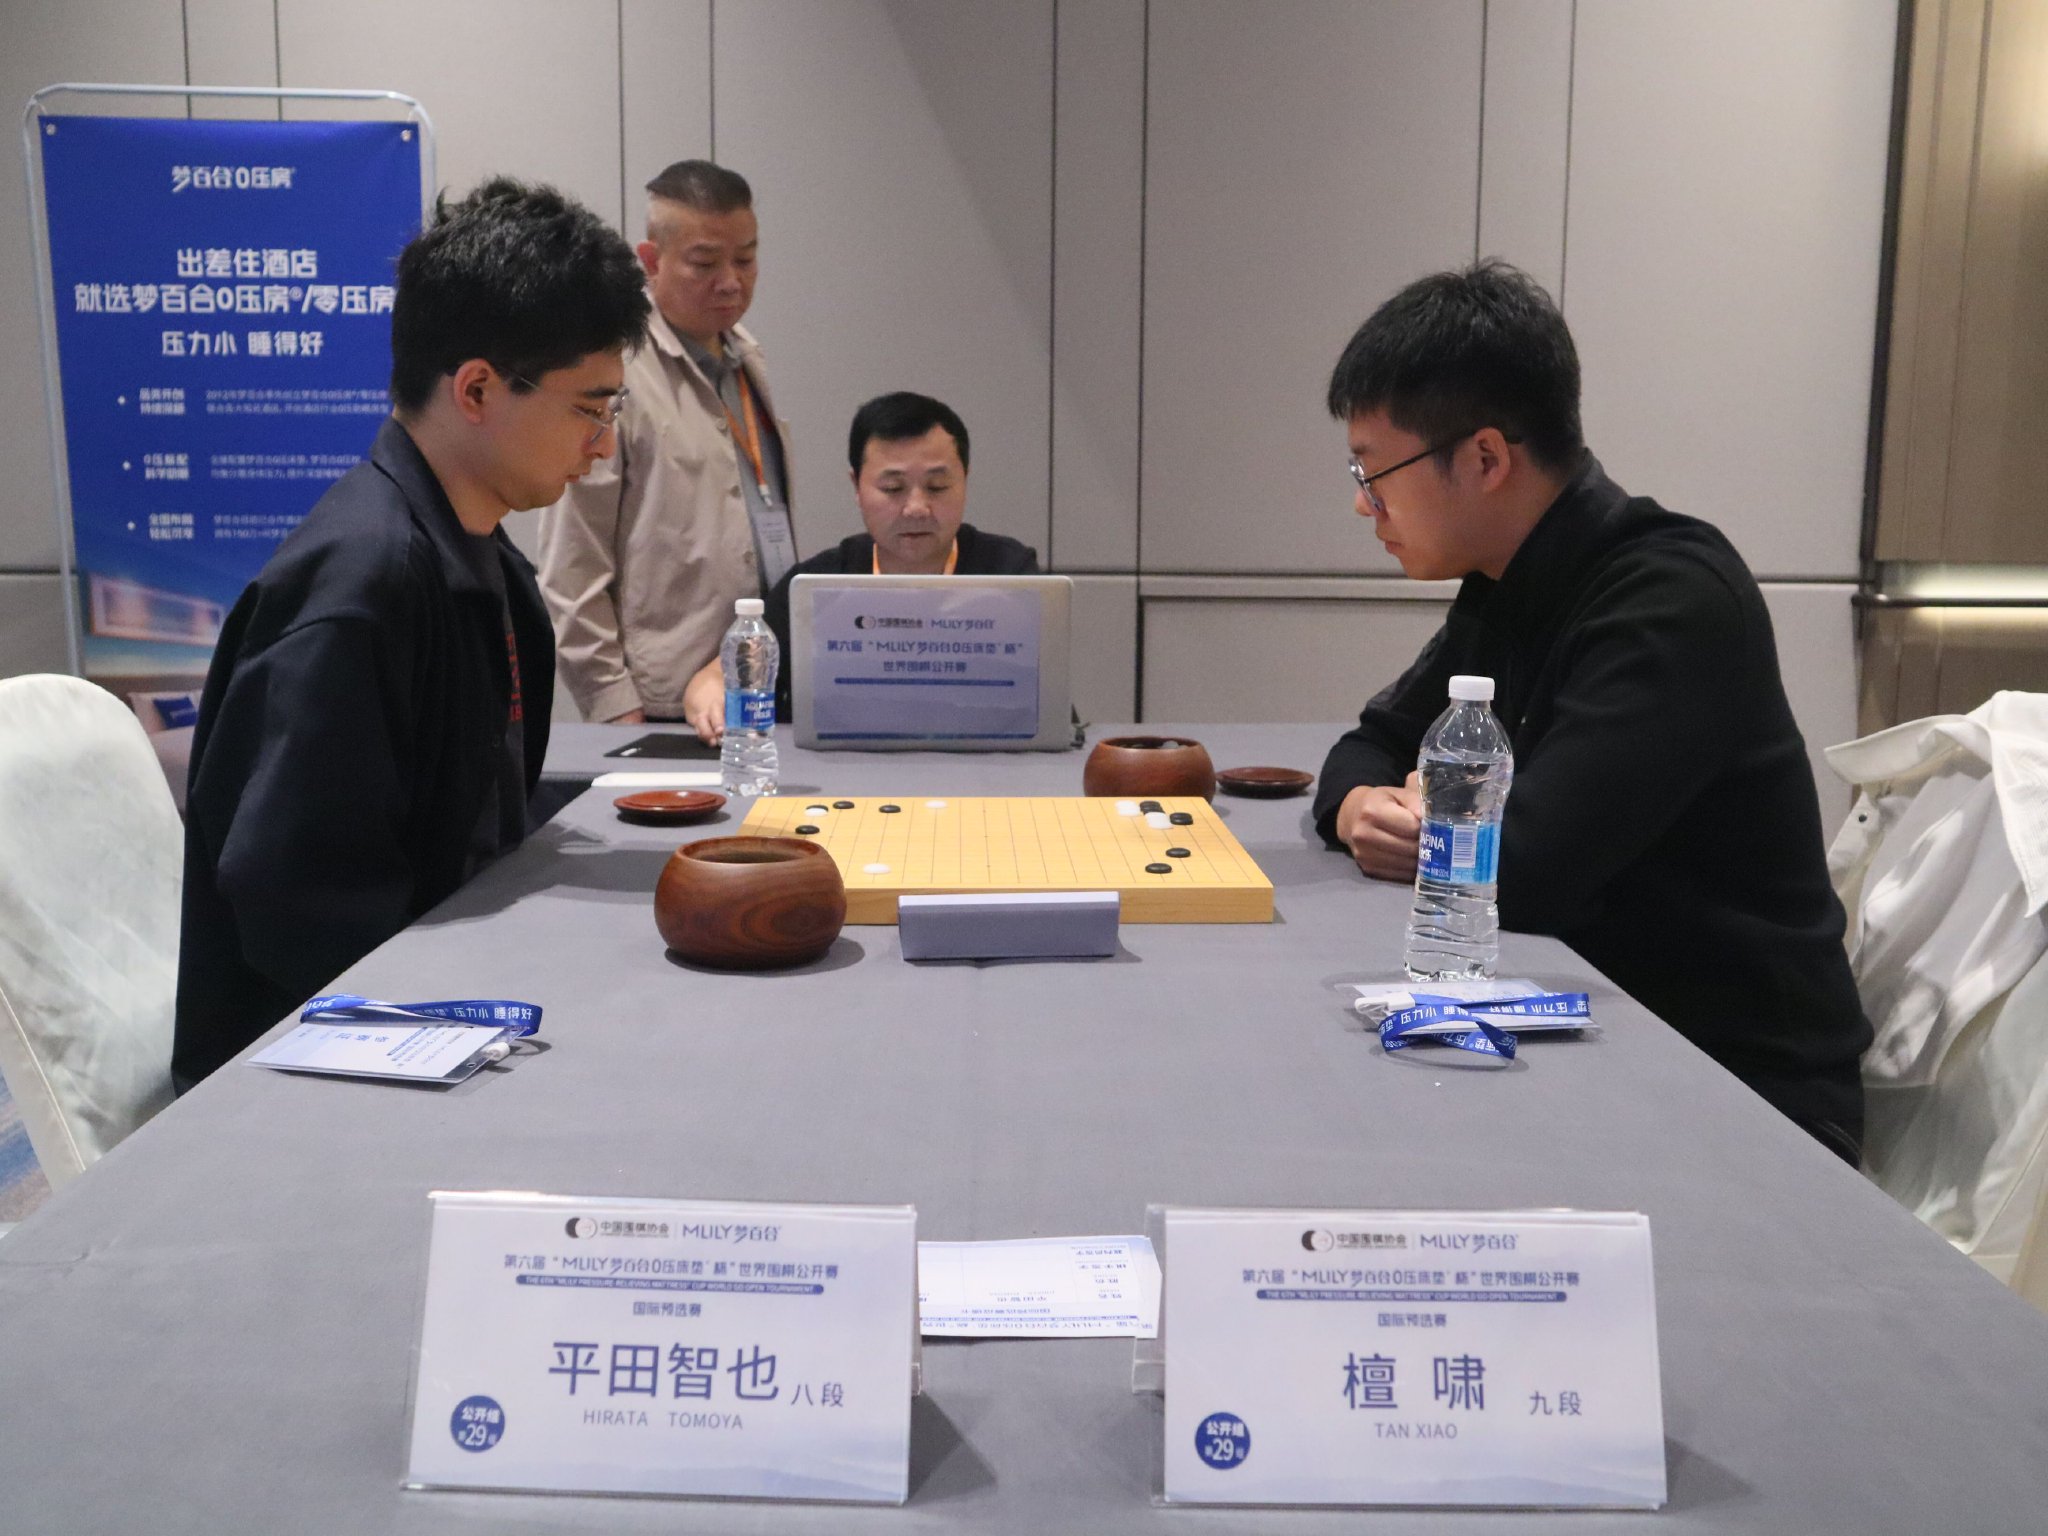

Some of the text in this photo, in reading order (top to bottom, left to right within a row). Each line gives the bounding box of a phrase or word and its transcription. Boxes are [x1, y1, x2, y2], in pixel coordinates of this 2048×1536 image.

[176, 248, 317, 278] 出差住酒店
[162, 331, 324, 357] 压力小 睡得好
[453, 1007, 489, 1019] 压力小
[494, 1006, 533, 1020] 睡得好
[1400, 1006, 1437, 1025] 压力小
[601, 1221, 669, 1233] 中国围棋协会
[633, 1302, 702, 1317] 国际预选赛
[1377, 1313, 1447, 1328] 国际预选赛
[548, 1341, 845, 1408] 平田智也 八段
[1529, 1390, 1583, 1417] 九段
[583, 1408, 744, 1430] HIRATA TOMOYA
[1375, 1422, 1458, 1440] TAN XIAO
